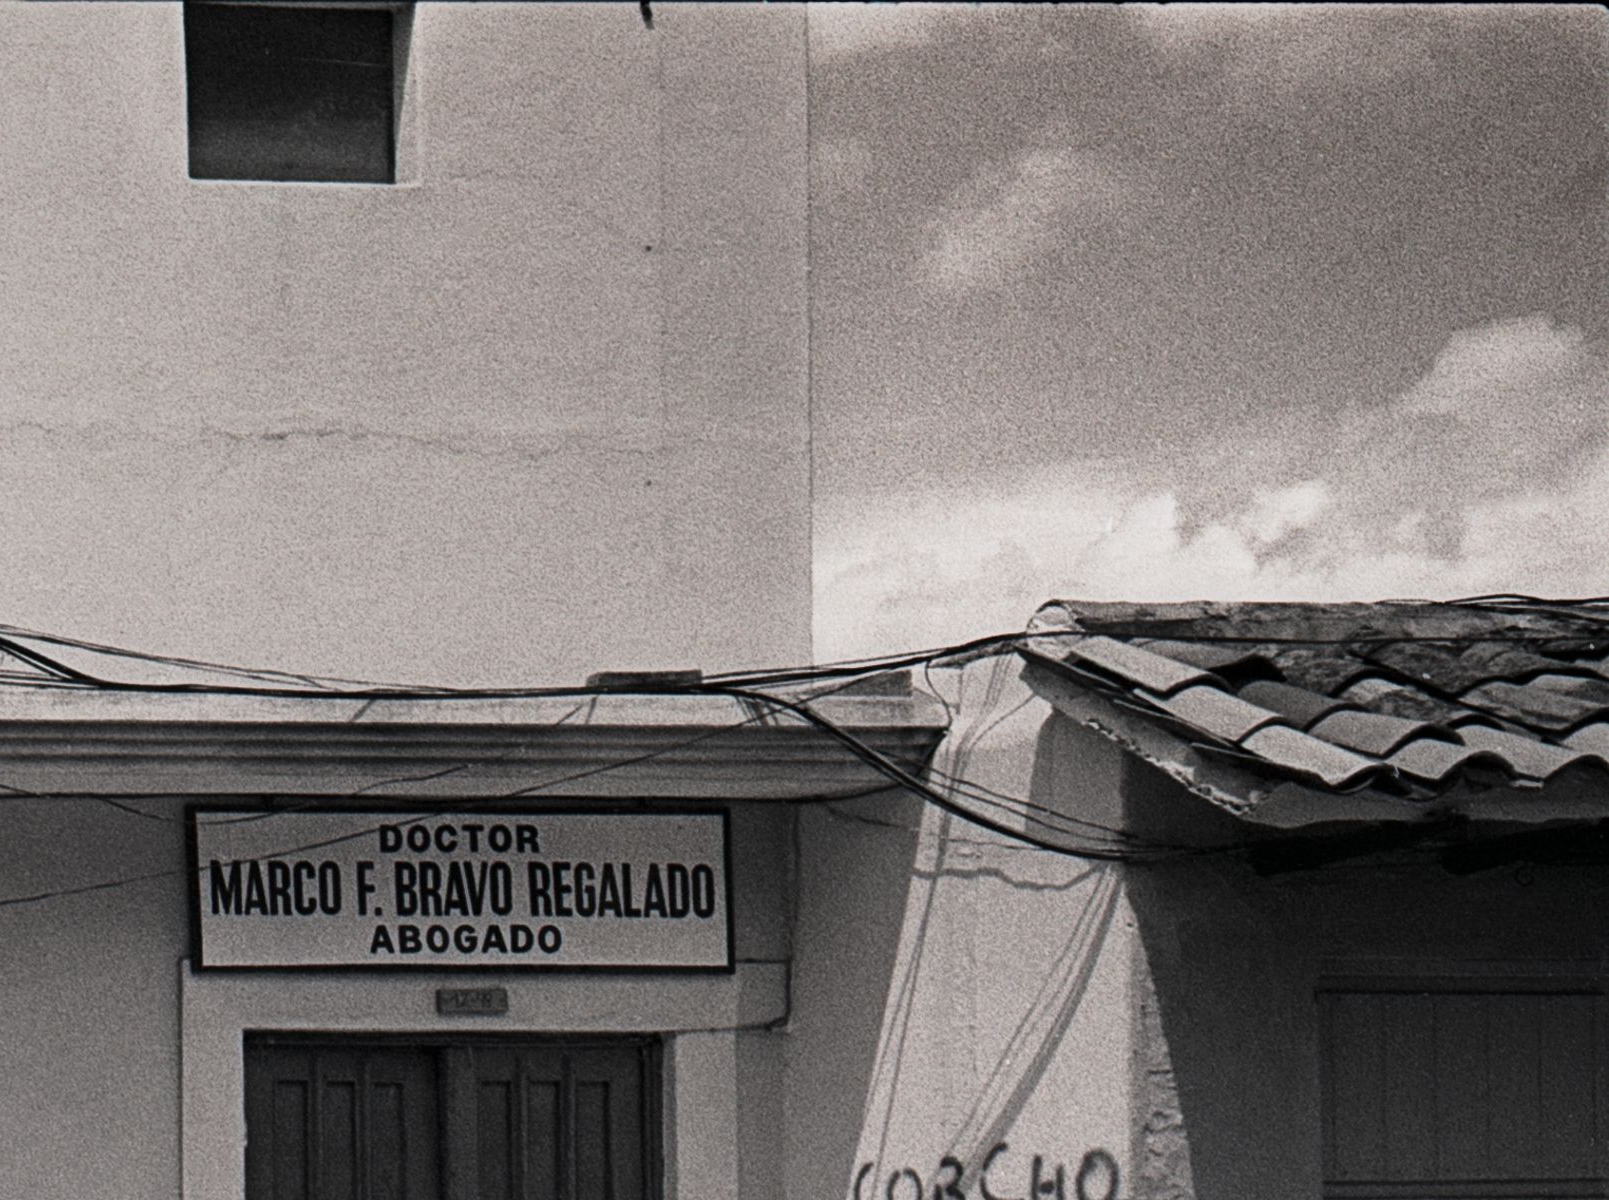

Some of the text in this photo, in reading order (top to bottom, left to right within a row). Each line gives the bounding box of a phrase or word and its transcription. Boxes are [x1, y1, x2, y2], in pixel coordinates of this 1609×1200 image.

[379, 825, 541, 854] DOCTOR
[210, 859, 716, 919] MARCO F. BRAVO REGALADO
[369, 924, 563, 955] ABOGADO
